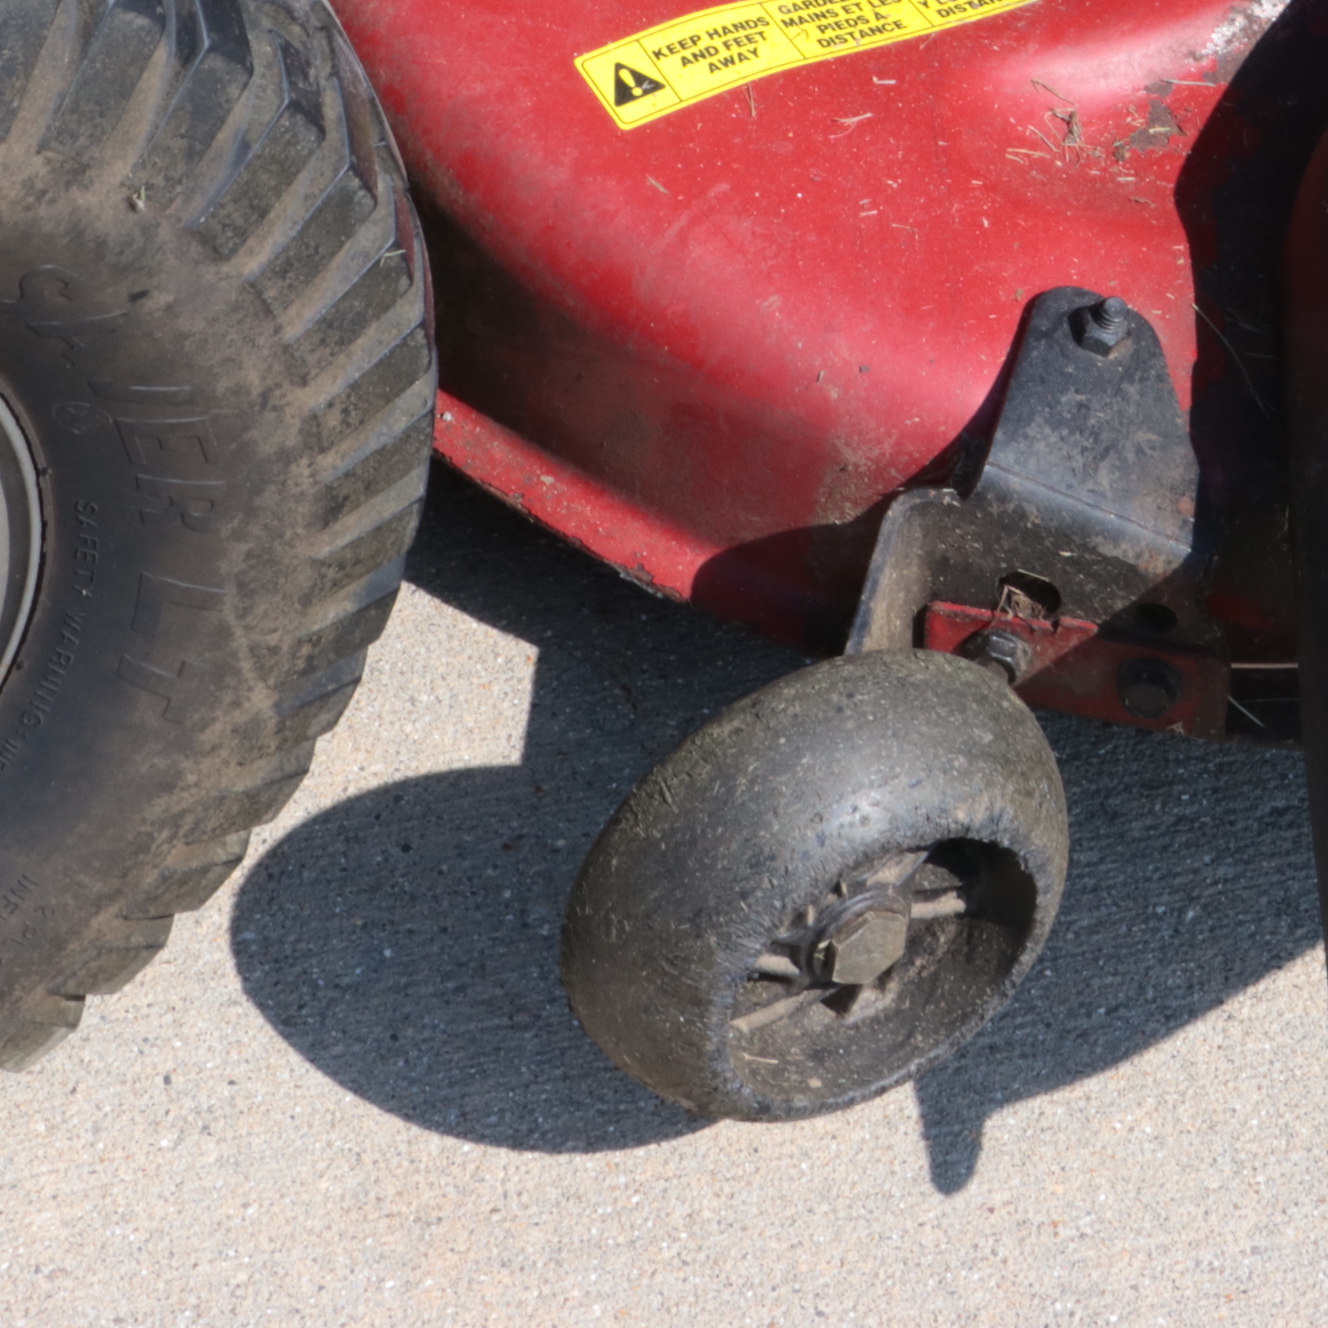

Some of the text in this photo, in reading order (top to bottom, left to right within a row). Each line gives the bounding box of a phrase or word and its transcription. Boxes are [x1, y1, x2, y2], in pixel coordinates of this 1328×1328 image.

[780, 8, 840, 28] MAINS
[841, 2, 864, 15] ET
[917, 0, 931, 10] Y
[815, 14, 870, 34] PIEDS
[816, 19, 907, 48] DISTANCE
[651, 16, 771, 61] KEEP HANDS
[679, 30, 768, 69] AND FEET
[707, 47, 761, 74] AWAY
[72, 498, 99, 599] SAFETY
